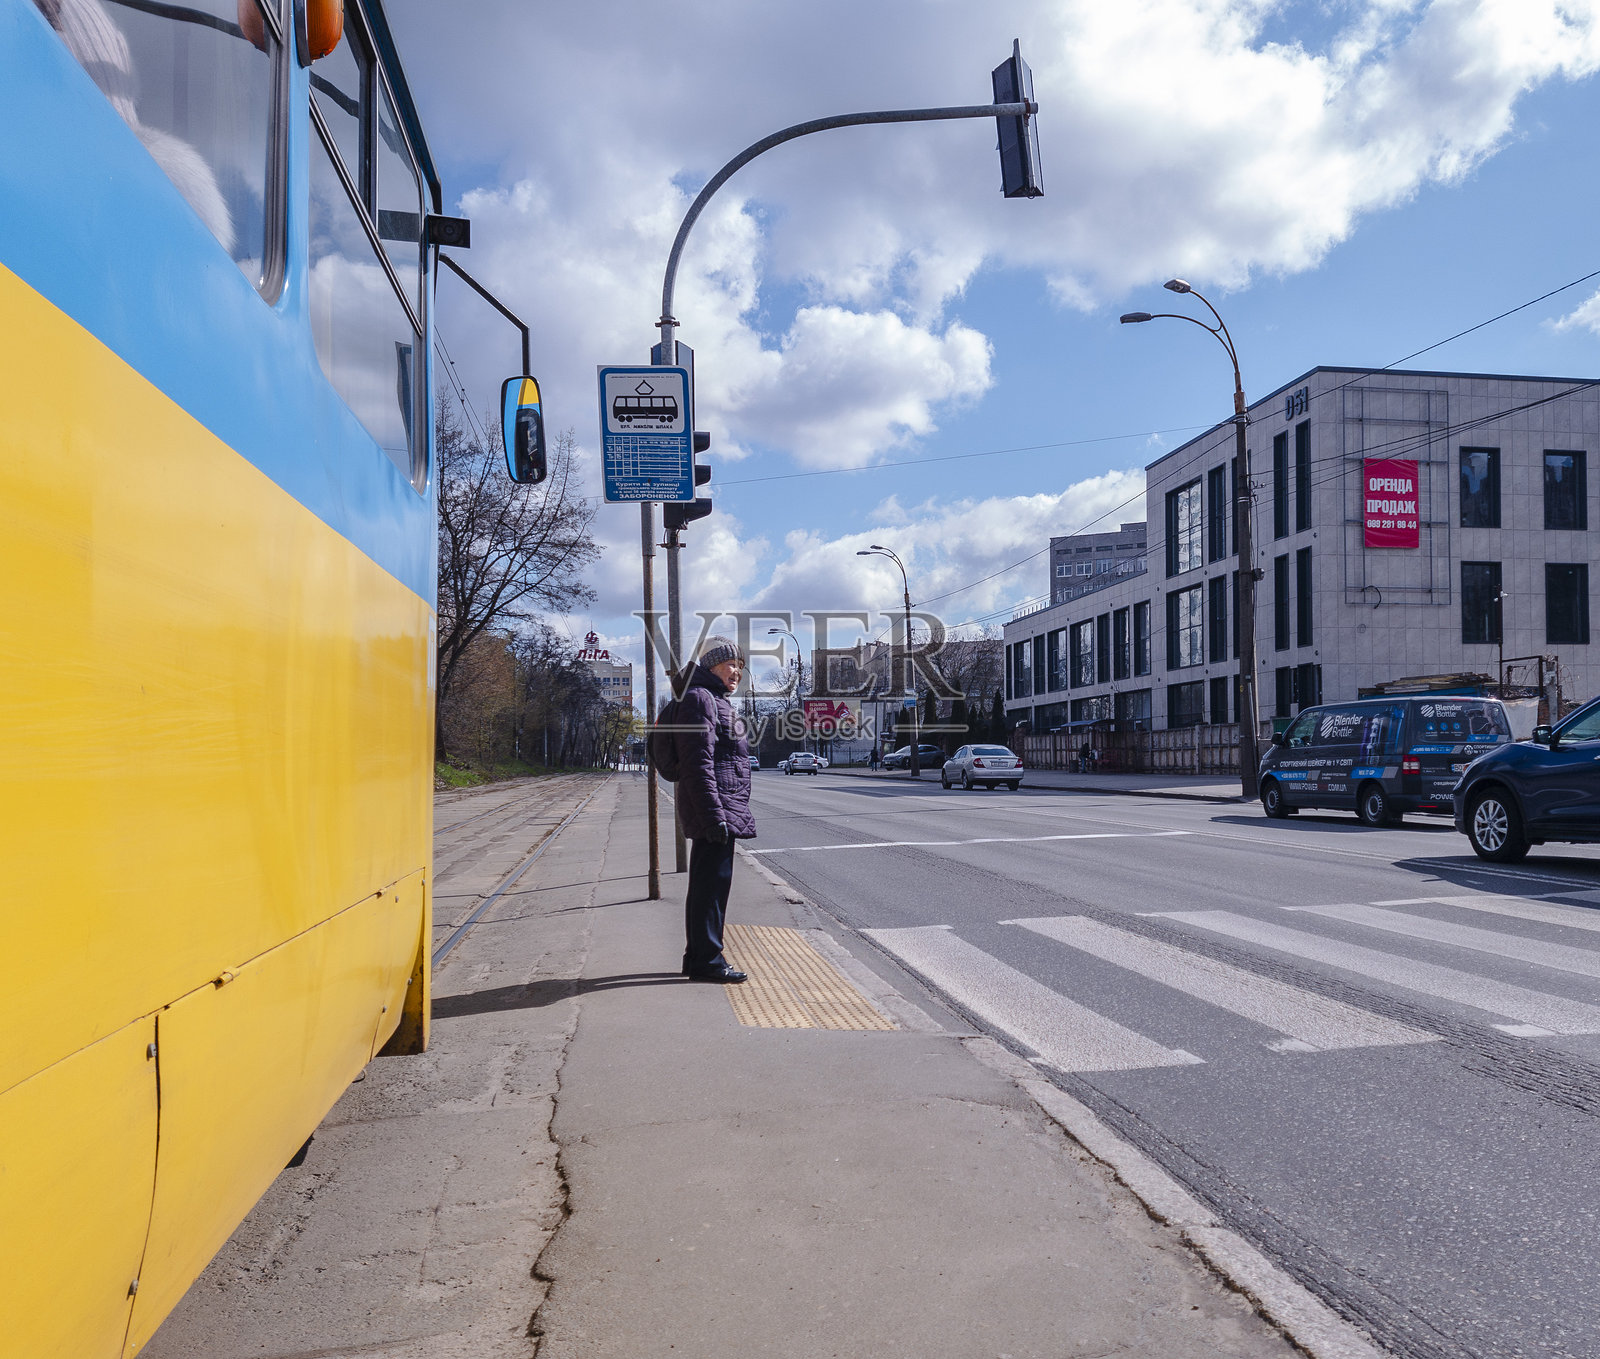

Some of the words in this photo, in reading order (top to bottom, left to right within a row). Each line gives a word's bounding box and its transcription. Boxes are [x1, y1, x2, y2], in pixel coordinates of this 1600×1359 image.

[1369, 478, 1413, 494] ОРЕНДА
[1366, 500, 1416, 516] ПРОДАЖ
[1407, 521, 1416, 529] 44
[1334, 714, 1363, 726] Blender
[1332, 726, 1354, 738] Bottle
